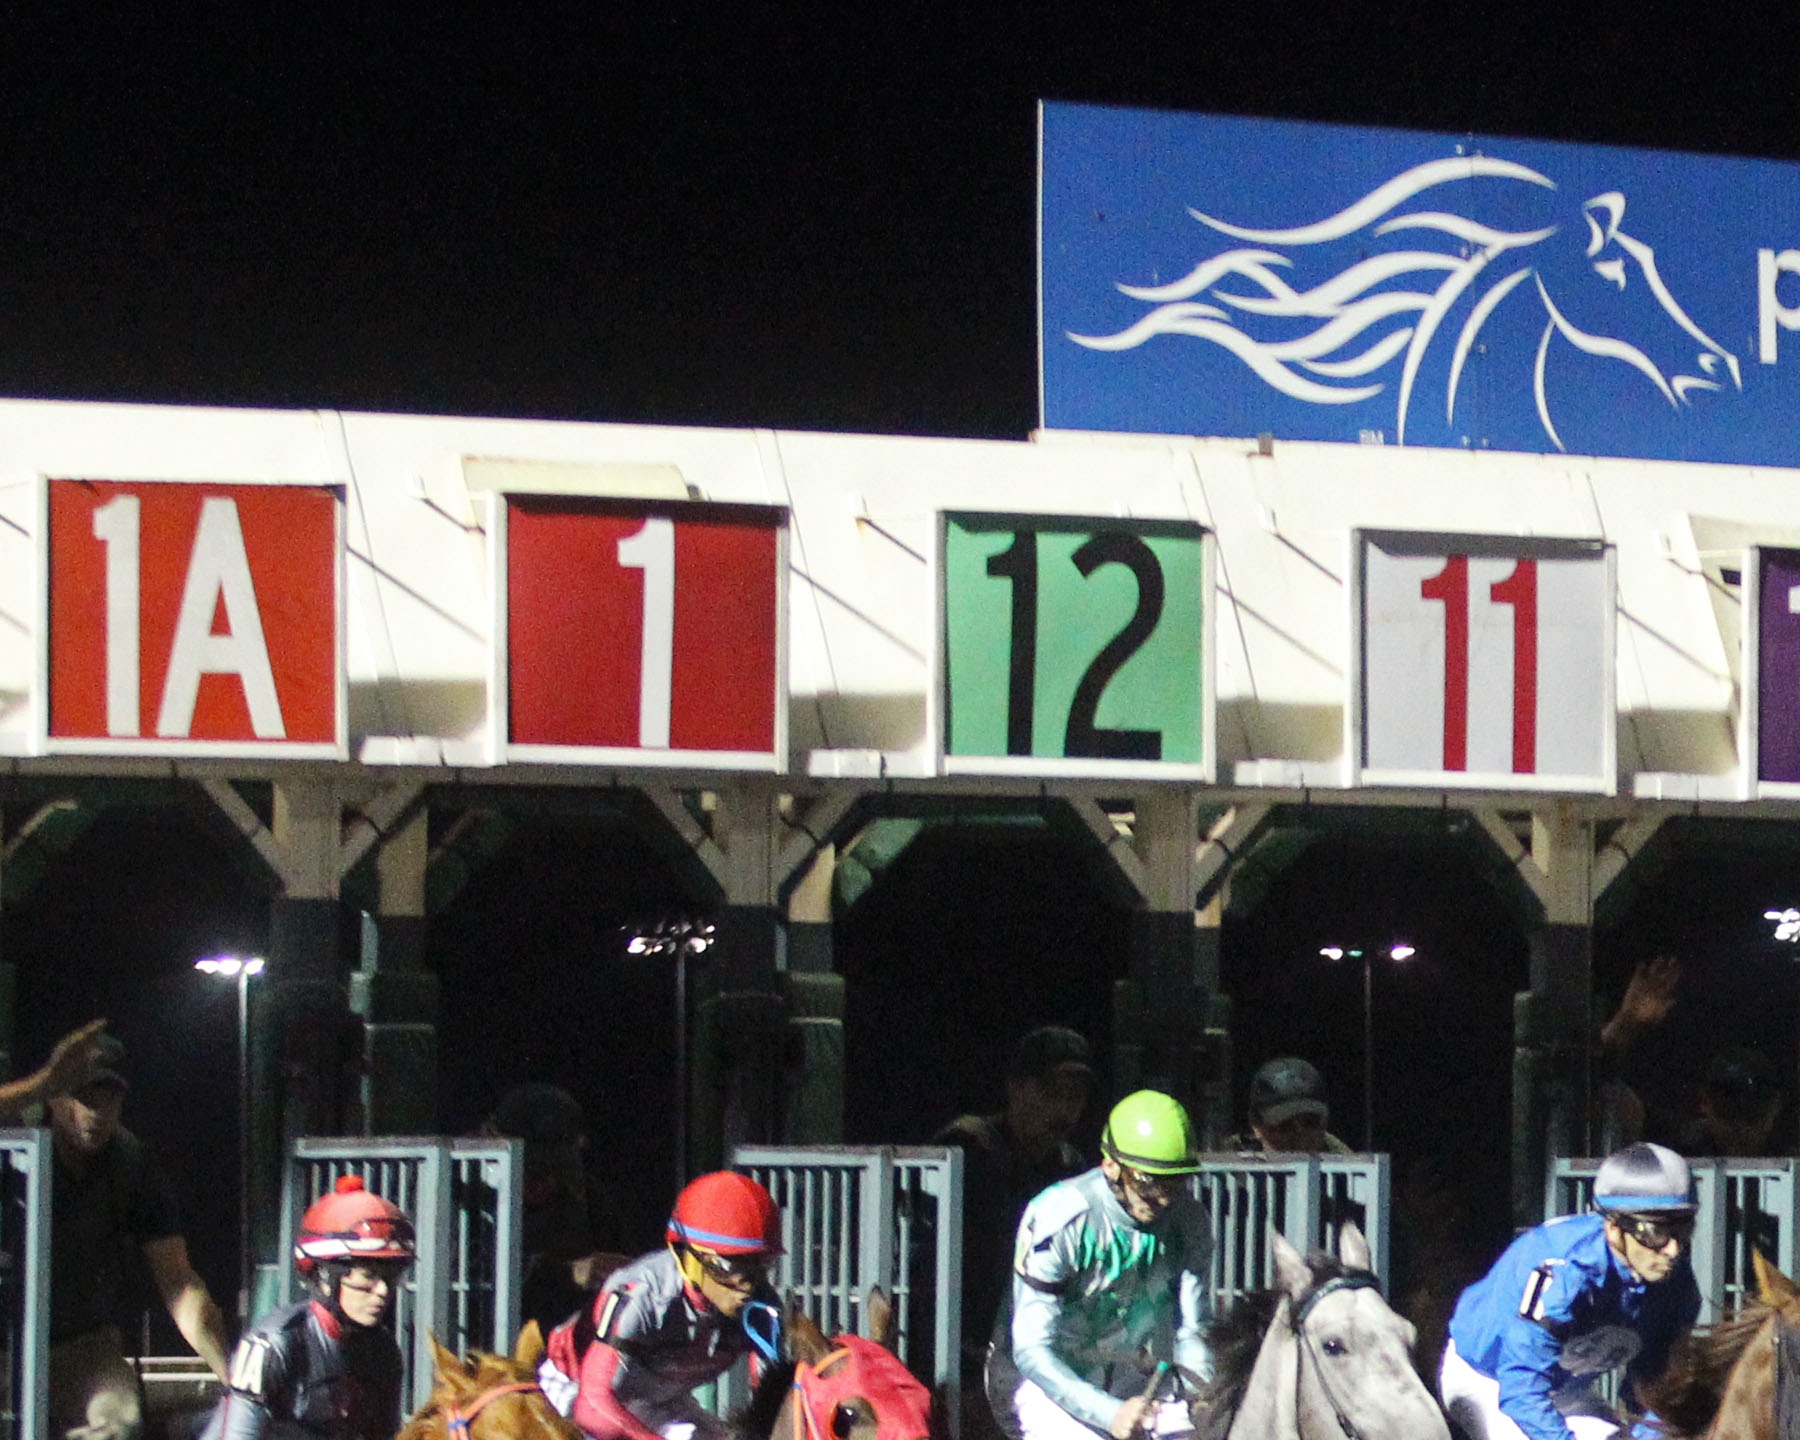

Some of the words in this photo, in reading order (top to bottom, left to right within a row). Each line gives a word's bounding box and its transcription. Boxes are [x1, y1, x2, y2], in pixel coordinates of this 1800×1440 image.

[92, 494, 287, 739] 1A
[616, 518, 675, 748] 1
[986, 531, 1164, 760] 12
[1420, 554, 1538, 774] 11
[230, 1338, 265, 1395] 1A
